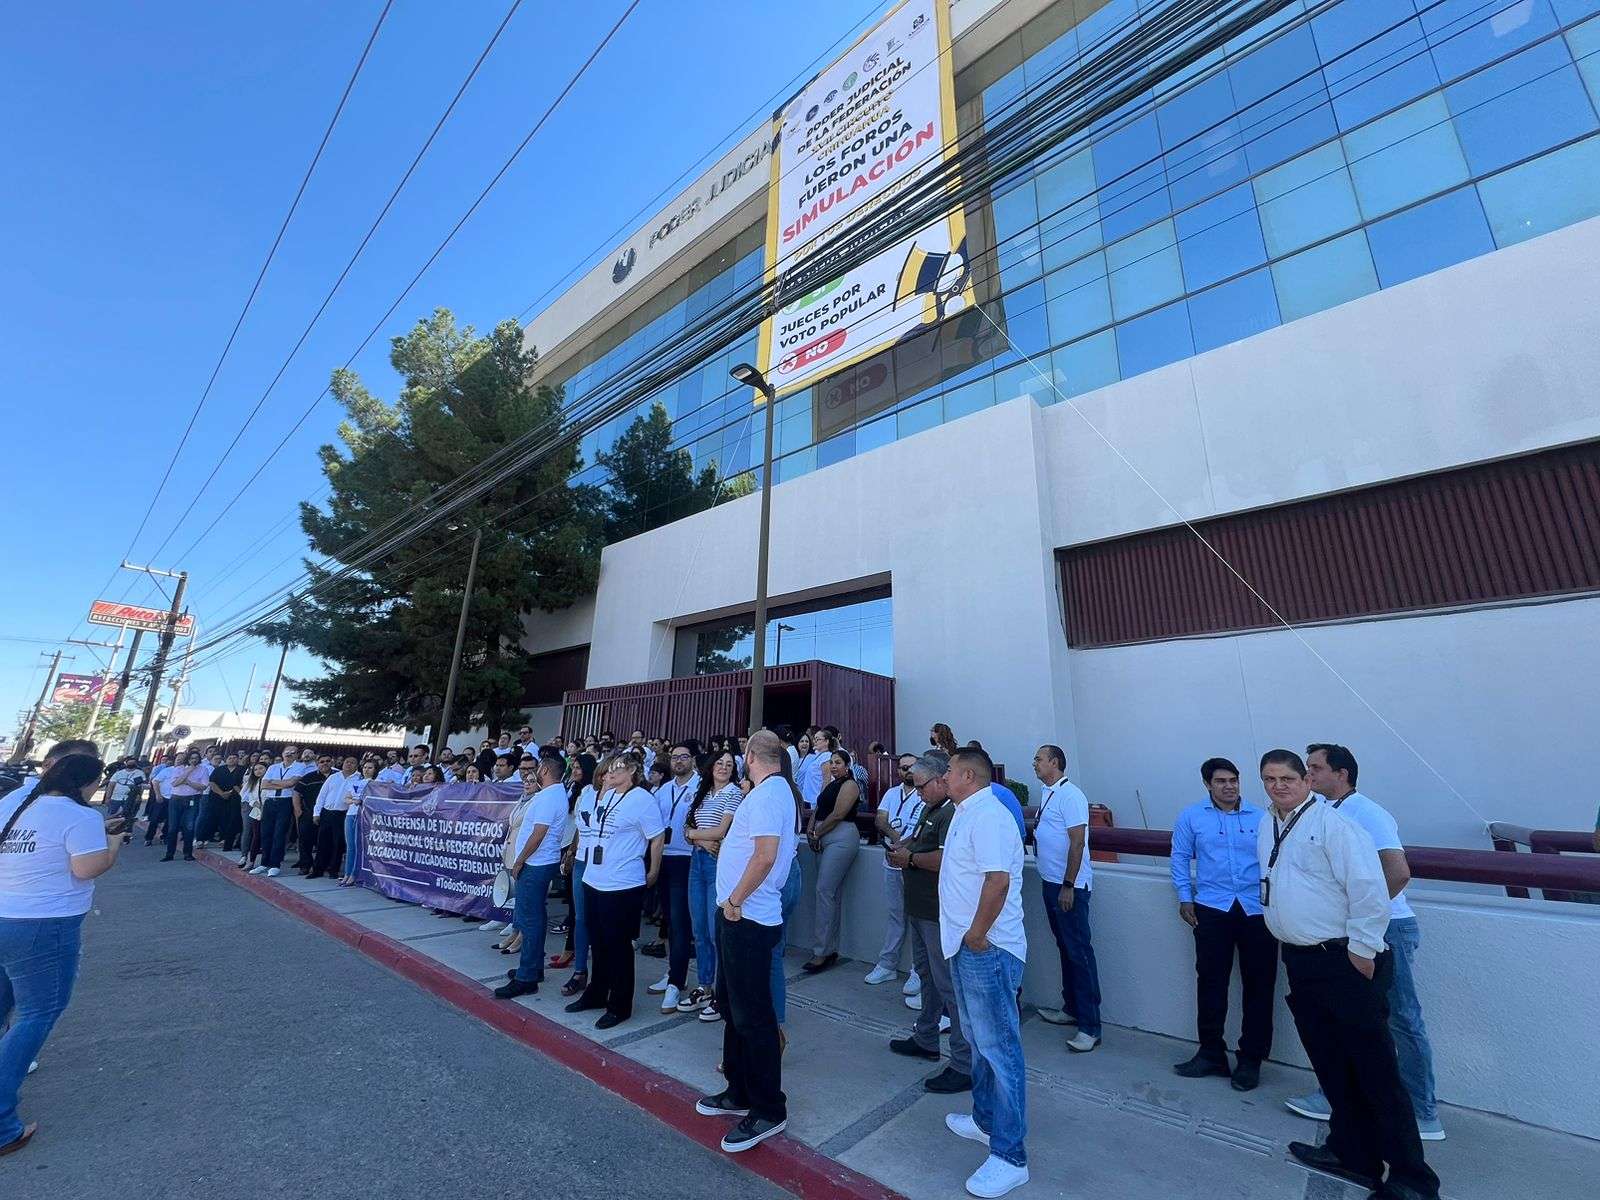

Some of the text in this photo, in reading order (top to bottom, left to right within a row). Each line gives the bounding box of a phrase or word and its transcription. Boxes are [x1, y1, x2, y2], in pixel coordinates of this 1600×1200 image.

[797, 139, 812, 155] DE
[815, 126, 829, 142] LA
[832, 62, 911, 127] FEDERACIÓN
[807, 57, 904, 138] PODER JUDICIAL
[782, 121, 935, 244] SIMULACIÓN
[798, 122, 912, 209] FUERON UNA
[804, 109, 903, 187] LOS FOROS
[649, 140, 772, 248] PODER JUDICIA
[779, 283, 886, 349] VOTO POPULAR
[780, 283, 861, 335] JUECES POR
[805, 340, 829, 360] NO
[367, 845, 408, 861] JUZGADORAS
[413, 851, 458, 870] JUZGADORES
[369, 830, 506, 859] PODER JUDICIAL DE LA FEDERACIÓN
[372, 814, 385, 826] POR
[393, 816, 426, 831] DEFENSA
[427, 818, 438, 832] DE
[439, 820, 453, 835] TUS
[455, 821, 504, 838] DERECHOS
